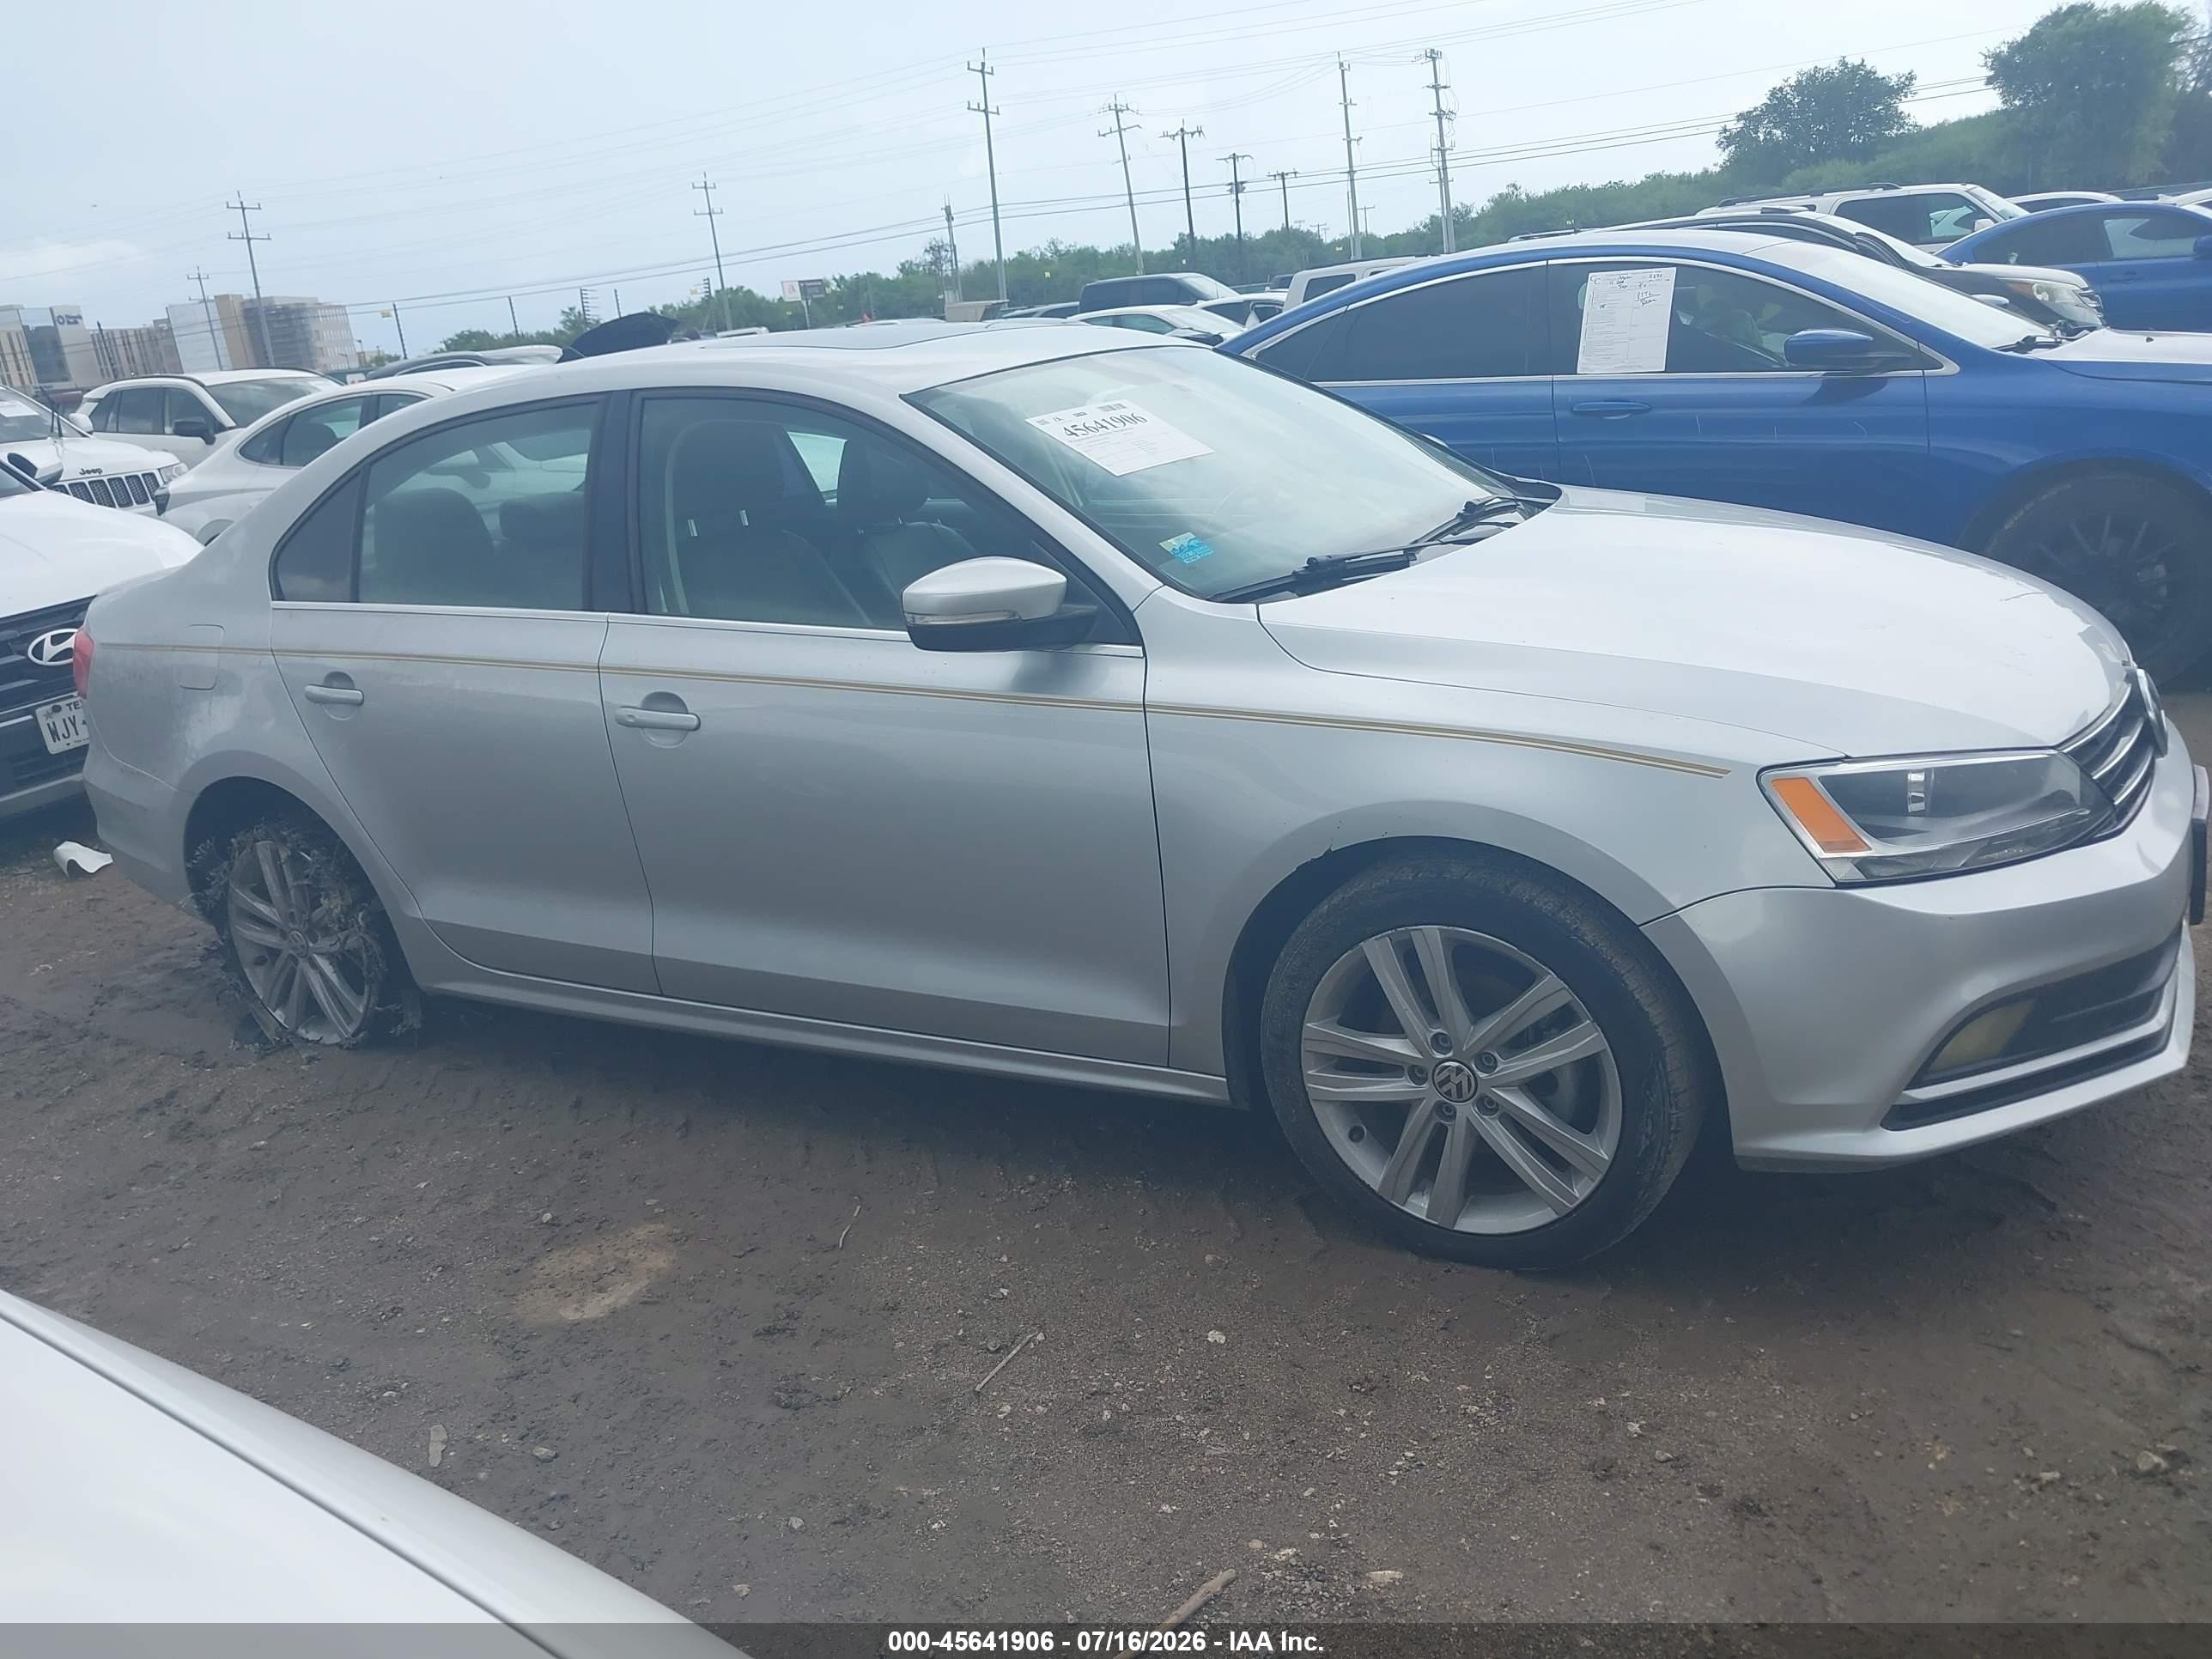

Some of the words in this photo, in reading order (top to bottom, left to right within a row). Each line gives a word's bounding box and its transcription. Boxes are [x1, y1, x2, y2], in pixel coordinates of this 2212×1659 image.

[1062, 412, 1148, 438] 45641906
[78, 467, 103, 476] Jeep
[65, 700, 82, 712] TE
[46, 714, 79, 743] WJY
